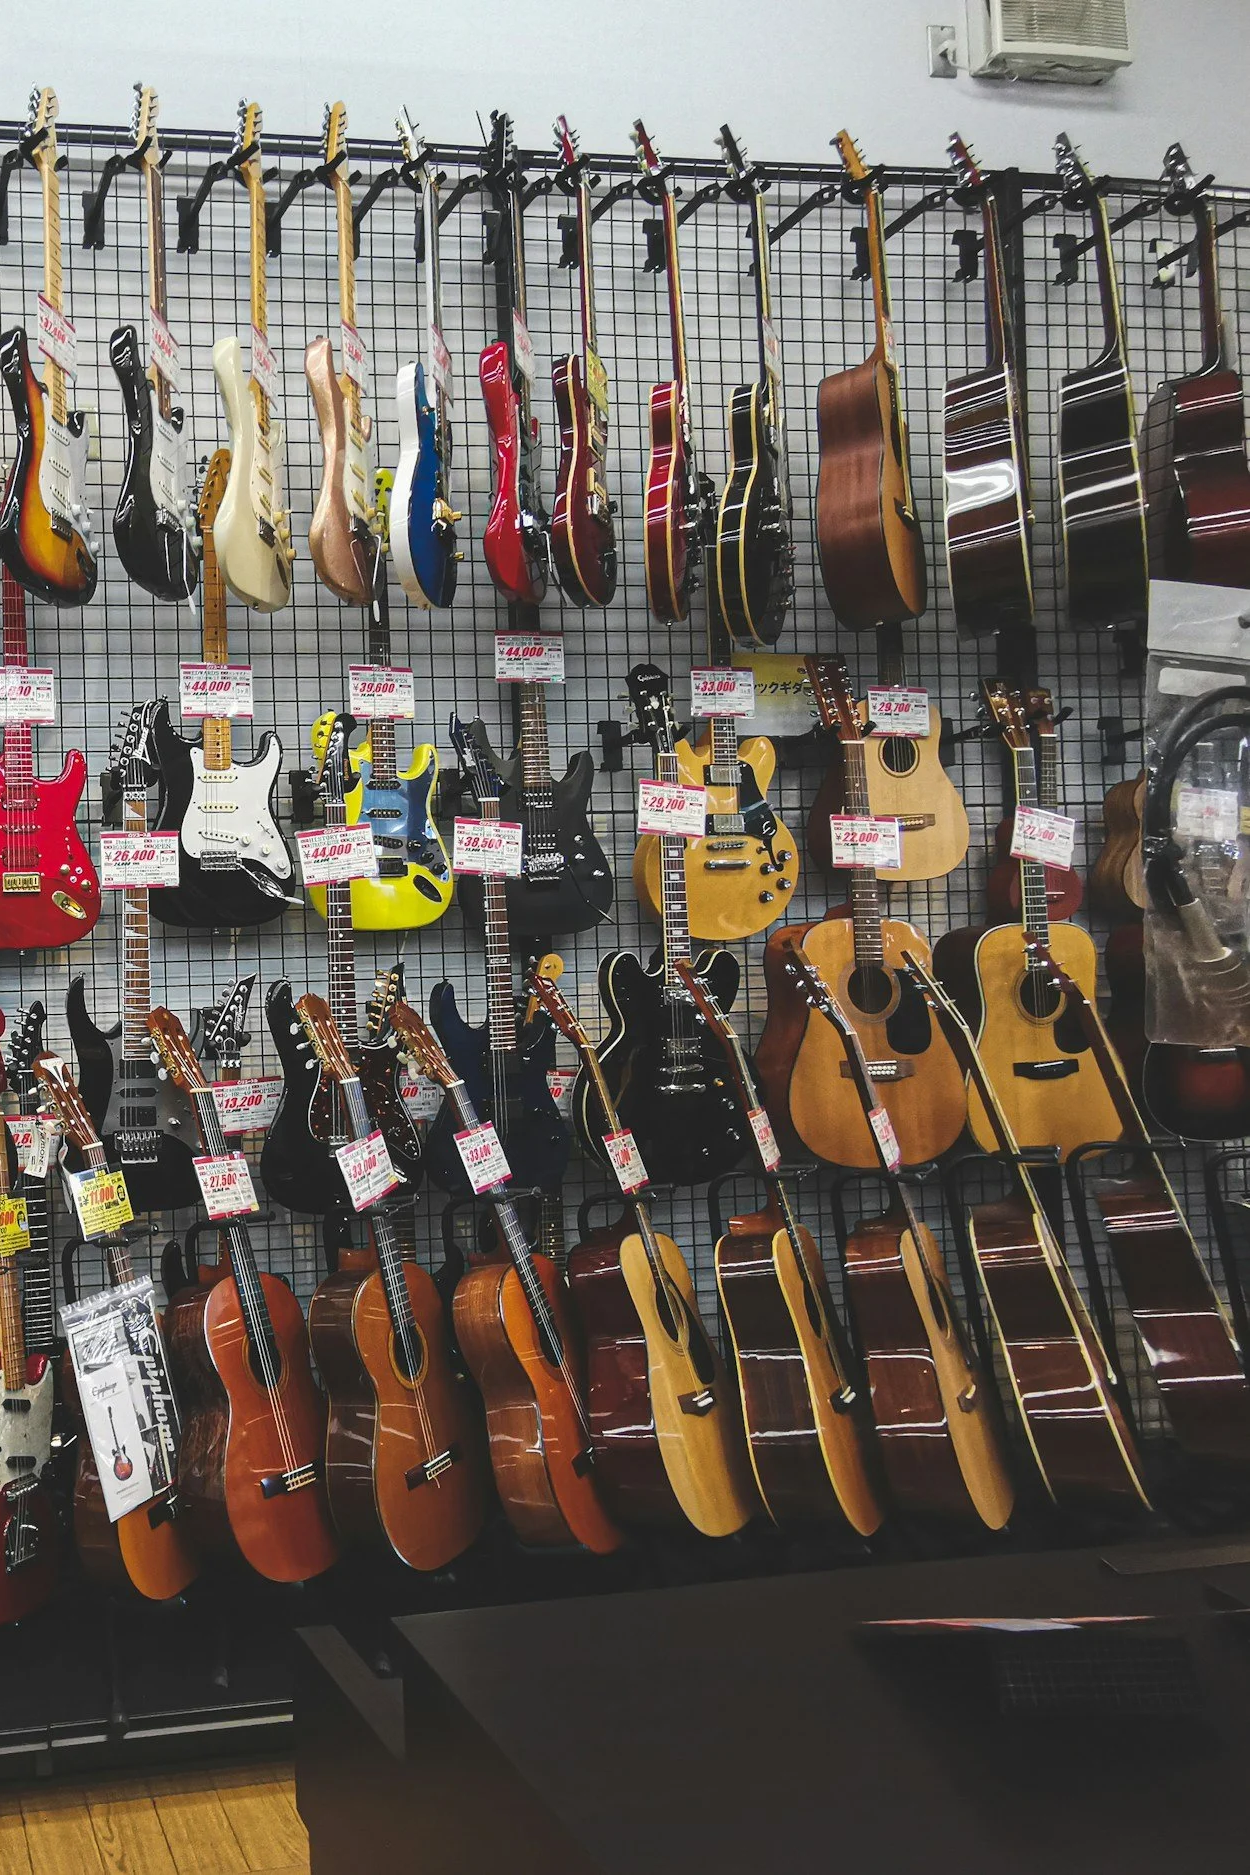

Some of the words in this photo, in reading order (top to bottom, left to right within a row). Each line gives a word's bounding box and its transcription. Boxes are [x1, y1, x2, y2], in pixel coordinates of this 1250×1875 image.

[498, 646, 544, 658] ¥44,000
[184, 681, 232, 692] ¥44,000
[353, 682, 395, 693] ¥39,600
[694, 681, 736, 692] ¥33,000
[644, 796, 685, 811] ¥29,700
[458, 836, 503, 850] ¥38,500
[835, 832, 879, 843] ¥22,000
[104, 850, 156, 862] ¥26,400
[303, 843, 352, 860] ¥44,000
[217, 1094, 263, 1109] ¥13,200
[347, 1154, 377, 1180] ¥33,000
[203, 1173, 237, 1189] ¥27,500
[138, 1325, 177, 1452] Epiphone
